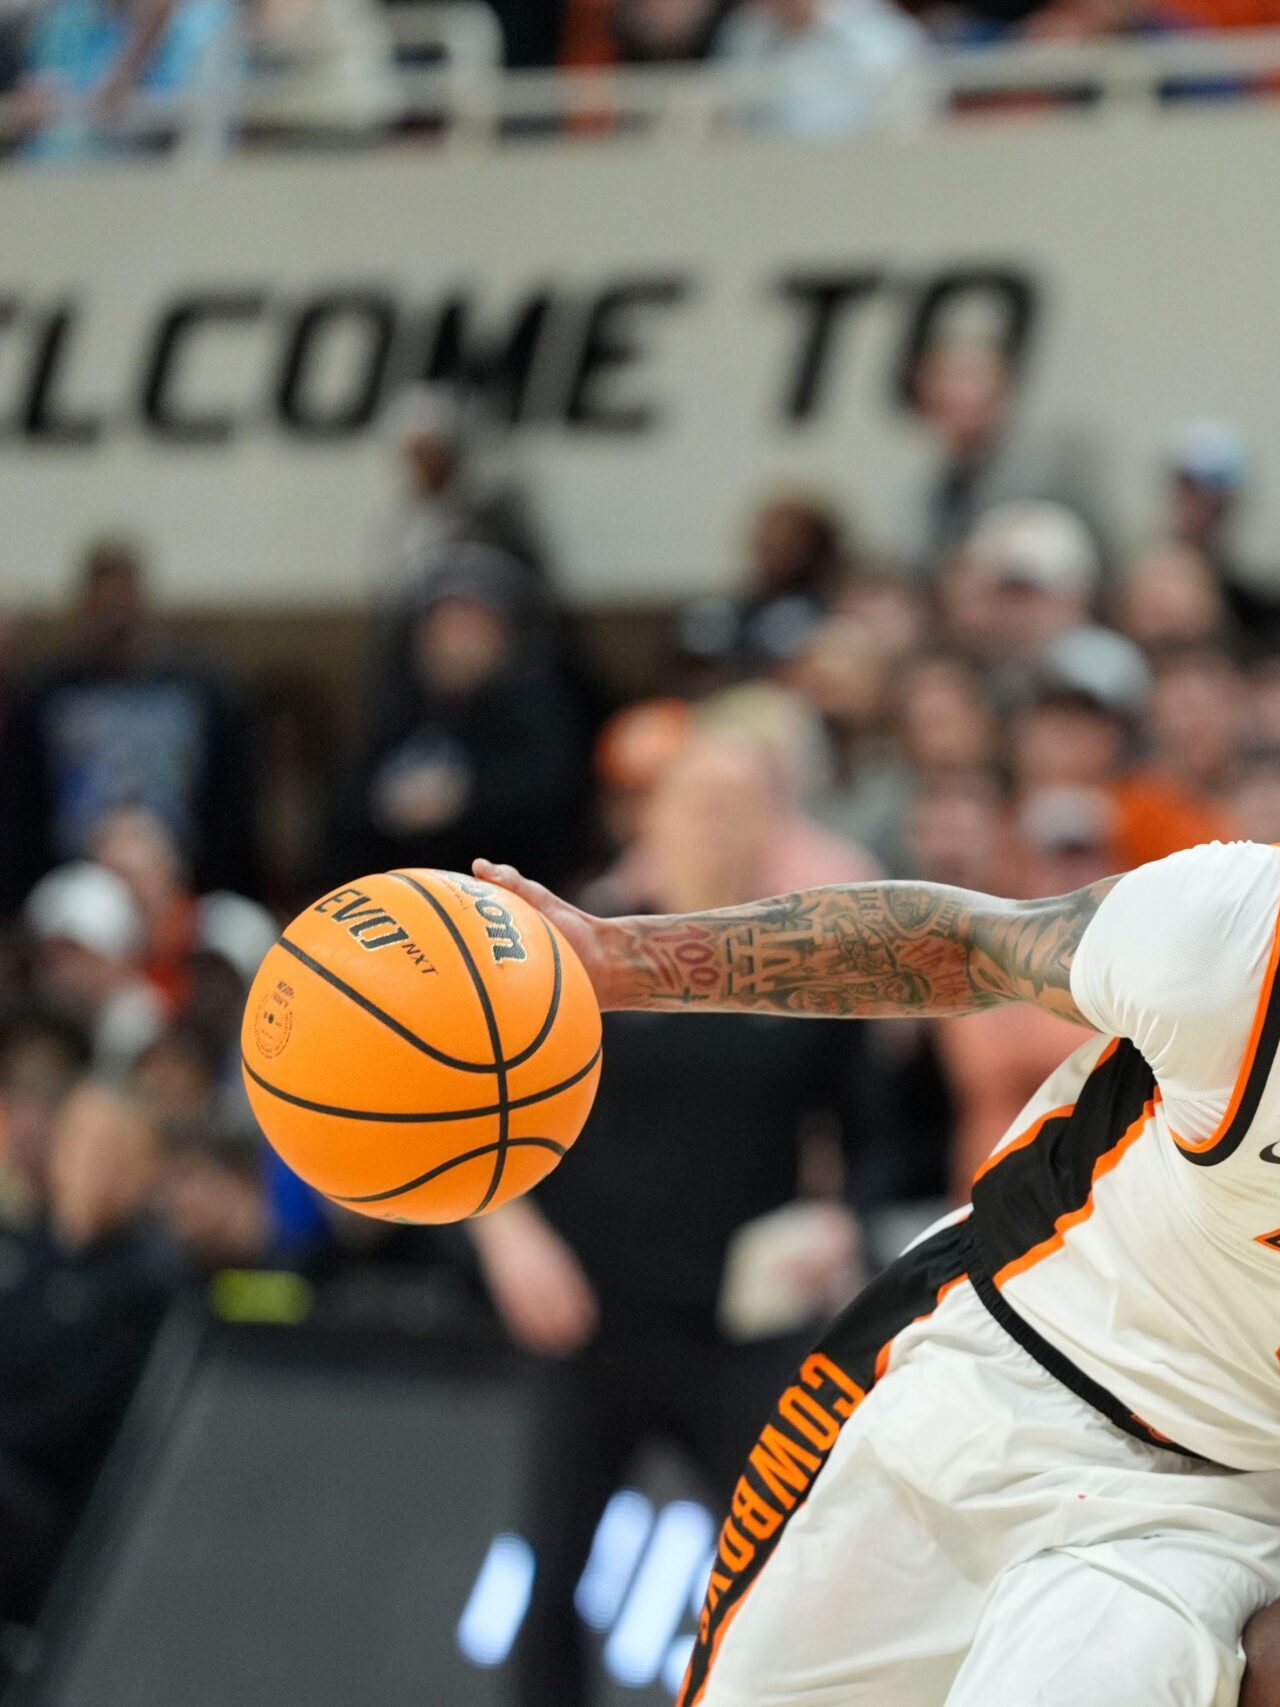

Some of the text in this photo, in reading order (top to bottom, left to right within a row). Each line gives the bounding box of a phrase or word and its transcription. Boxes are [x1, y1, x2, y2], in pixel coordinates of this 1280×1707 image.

[0, 264, 1038, 448] LCOME TO
[313, 887, 410, 952] EVO
[401, 942, 438, 976] NXT
